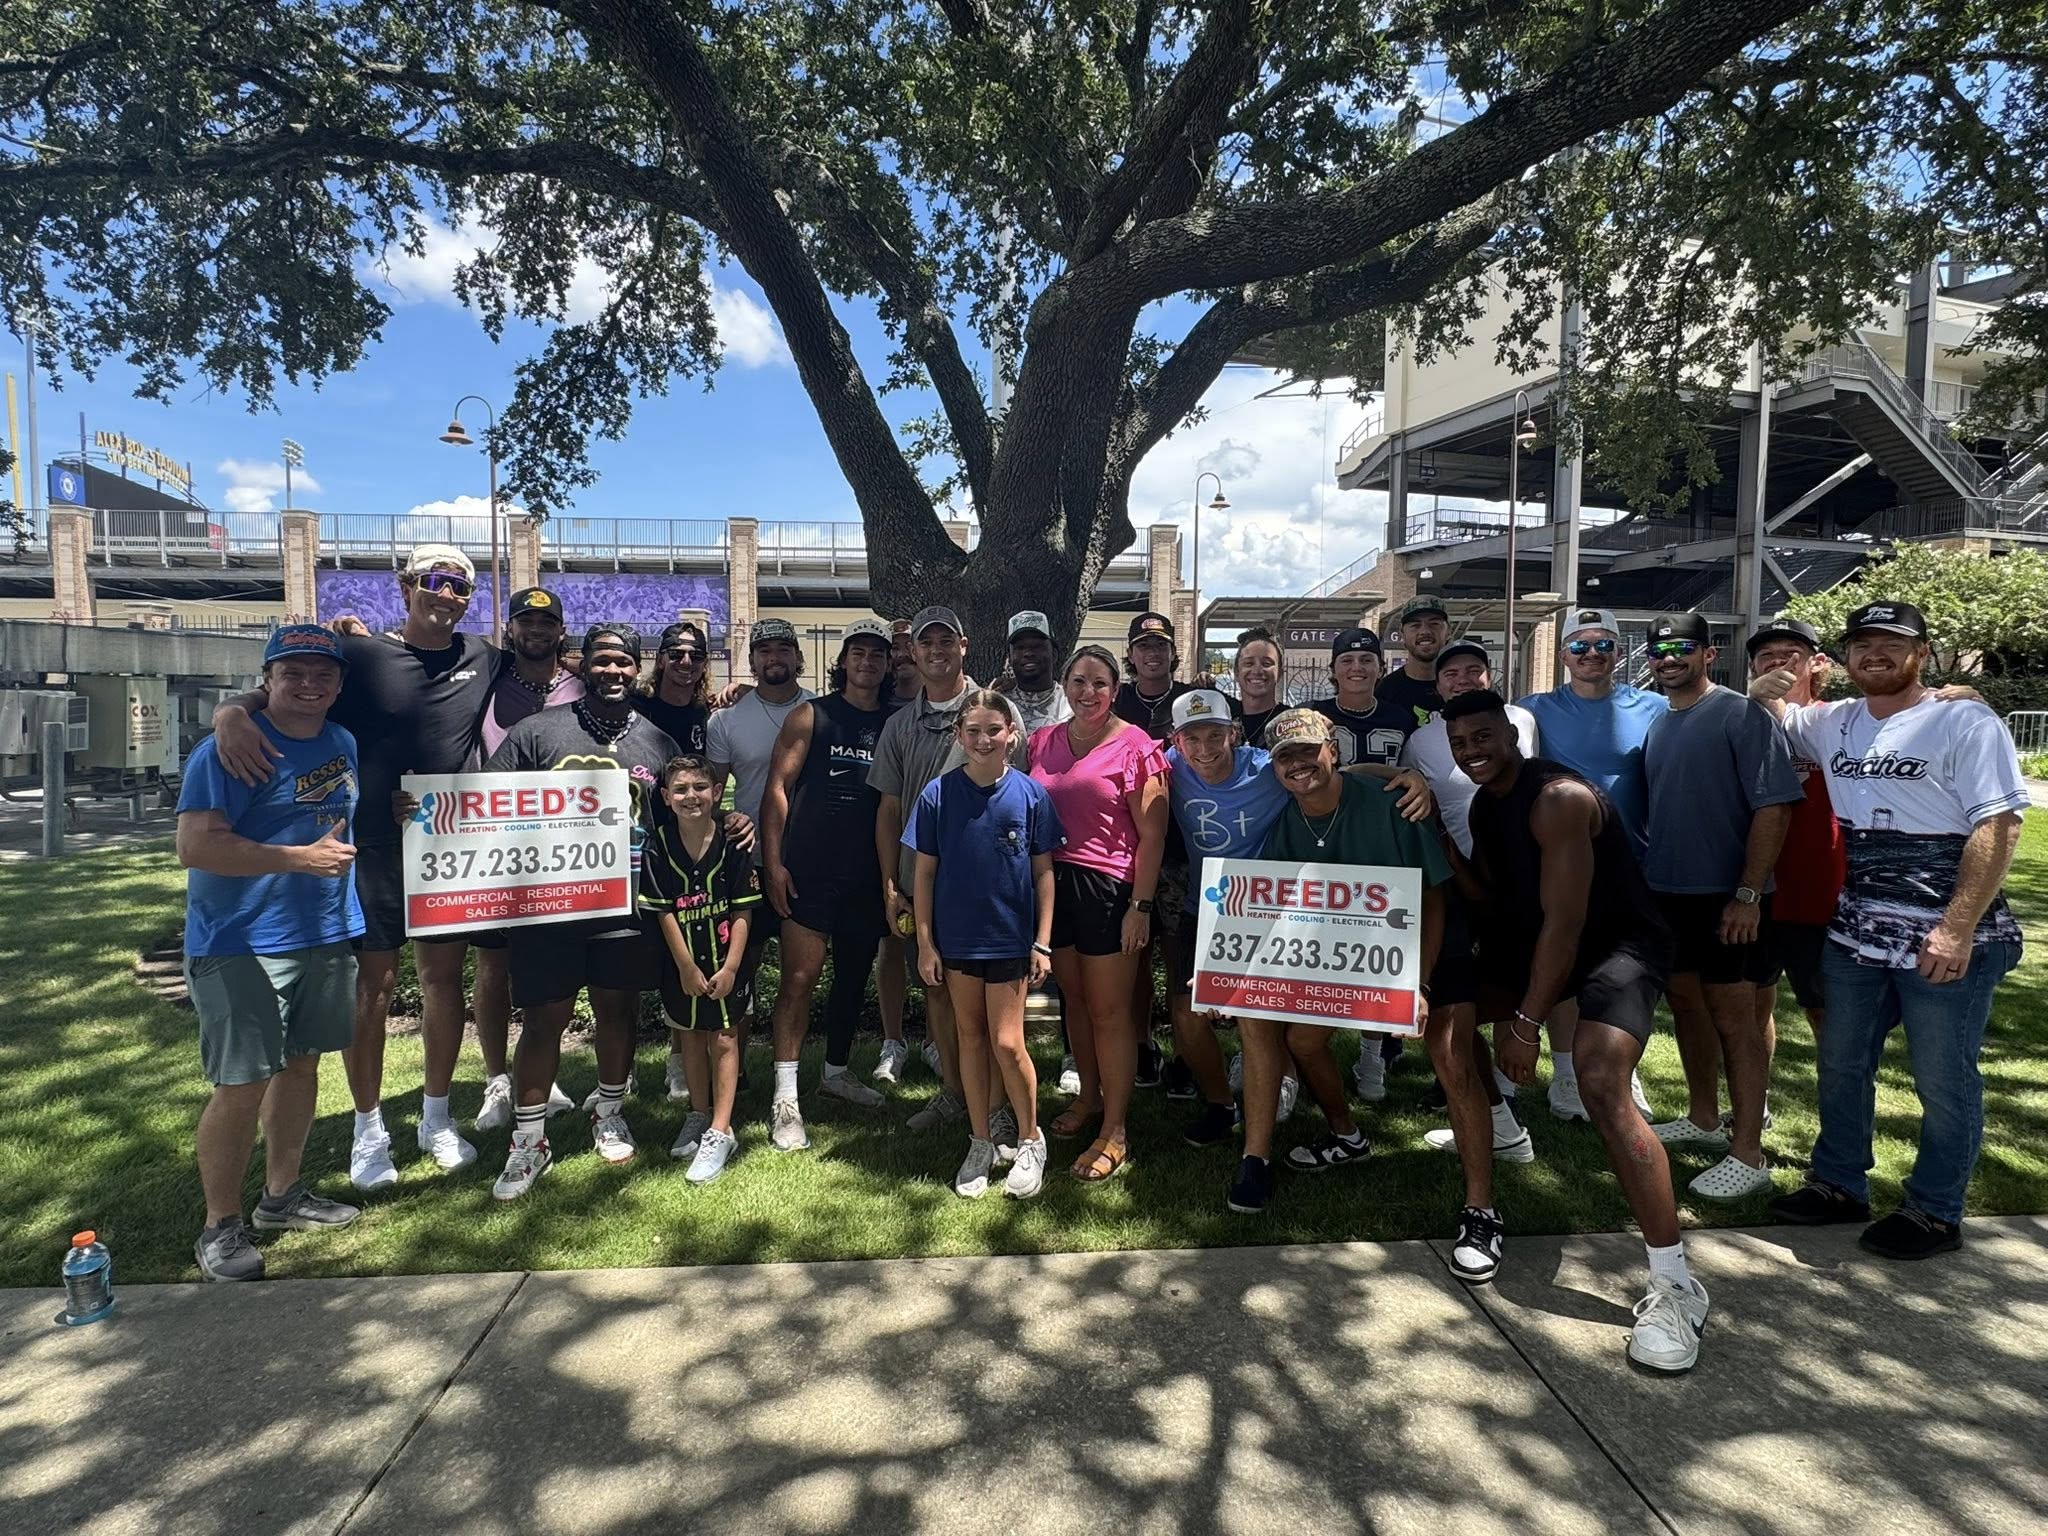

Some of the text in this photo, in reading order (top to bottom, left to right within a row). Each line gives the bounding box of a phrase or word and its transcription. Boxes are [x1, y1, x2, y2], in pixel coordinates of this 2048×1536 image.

[96, 430, 190, 484] ALEX BOX STADIUM
[106, 450, 185, 492] SKIP BERTMAN FIELD
[1290, 631, 1326, 642] GATE
[830, 745, 874, 761] MARL
[296, 755, 347, 793] RCSSC
[459, 786, 602, 820] REED'S
[459, 820, 596, 834] HEATING COOLING ELECTRICAL
[420, 841, 617, 882] 337.233.5200
[426, 883, 607, 908] COMMERCIAL RESIDENTIAL
[676, 892, 708, 909] ARTY
[1249, 876, 1390, 914] REED'S
[465, 900, 573, 919] SALES SERVICE
[1247, 911, 1383, 928] HEATING COOLING ELECTRICAL
[718, 920, 730, 944] 9
[1209, 931, 1404, 976] 337.233.5200
[1211, 976, 1390, 1003] COMMERCIAL RESIDENTIAL
[1245, 994, 1353, 1015] SALES SERVICE
